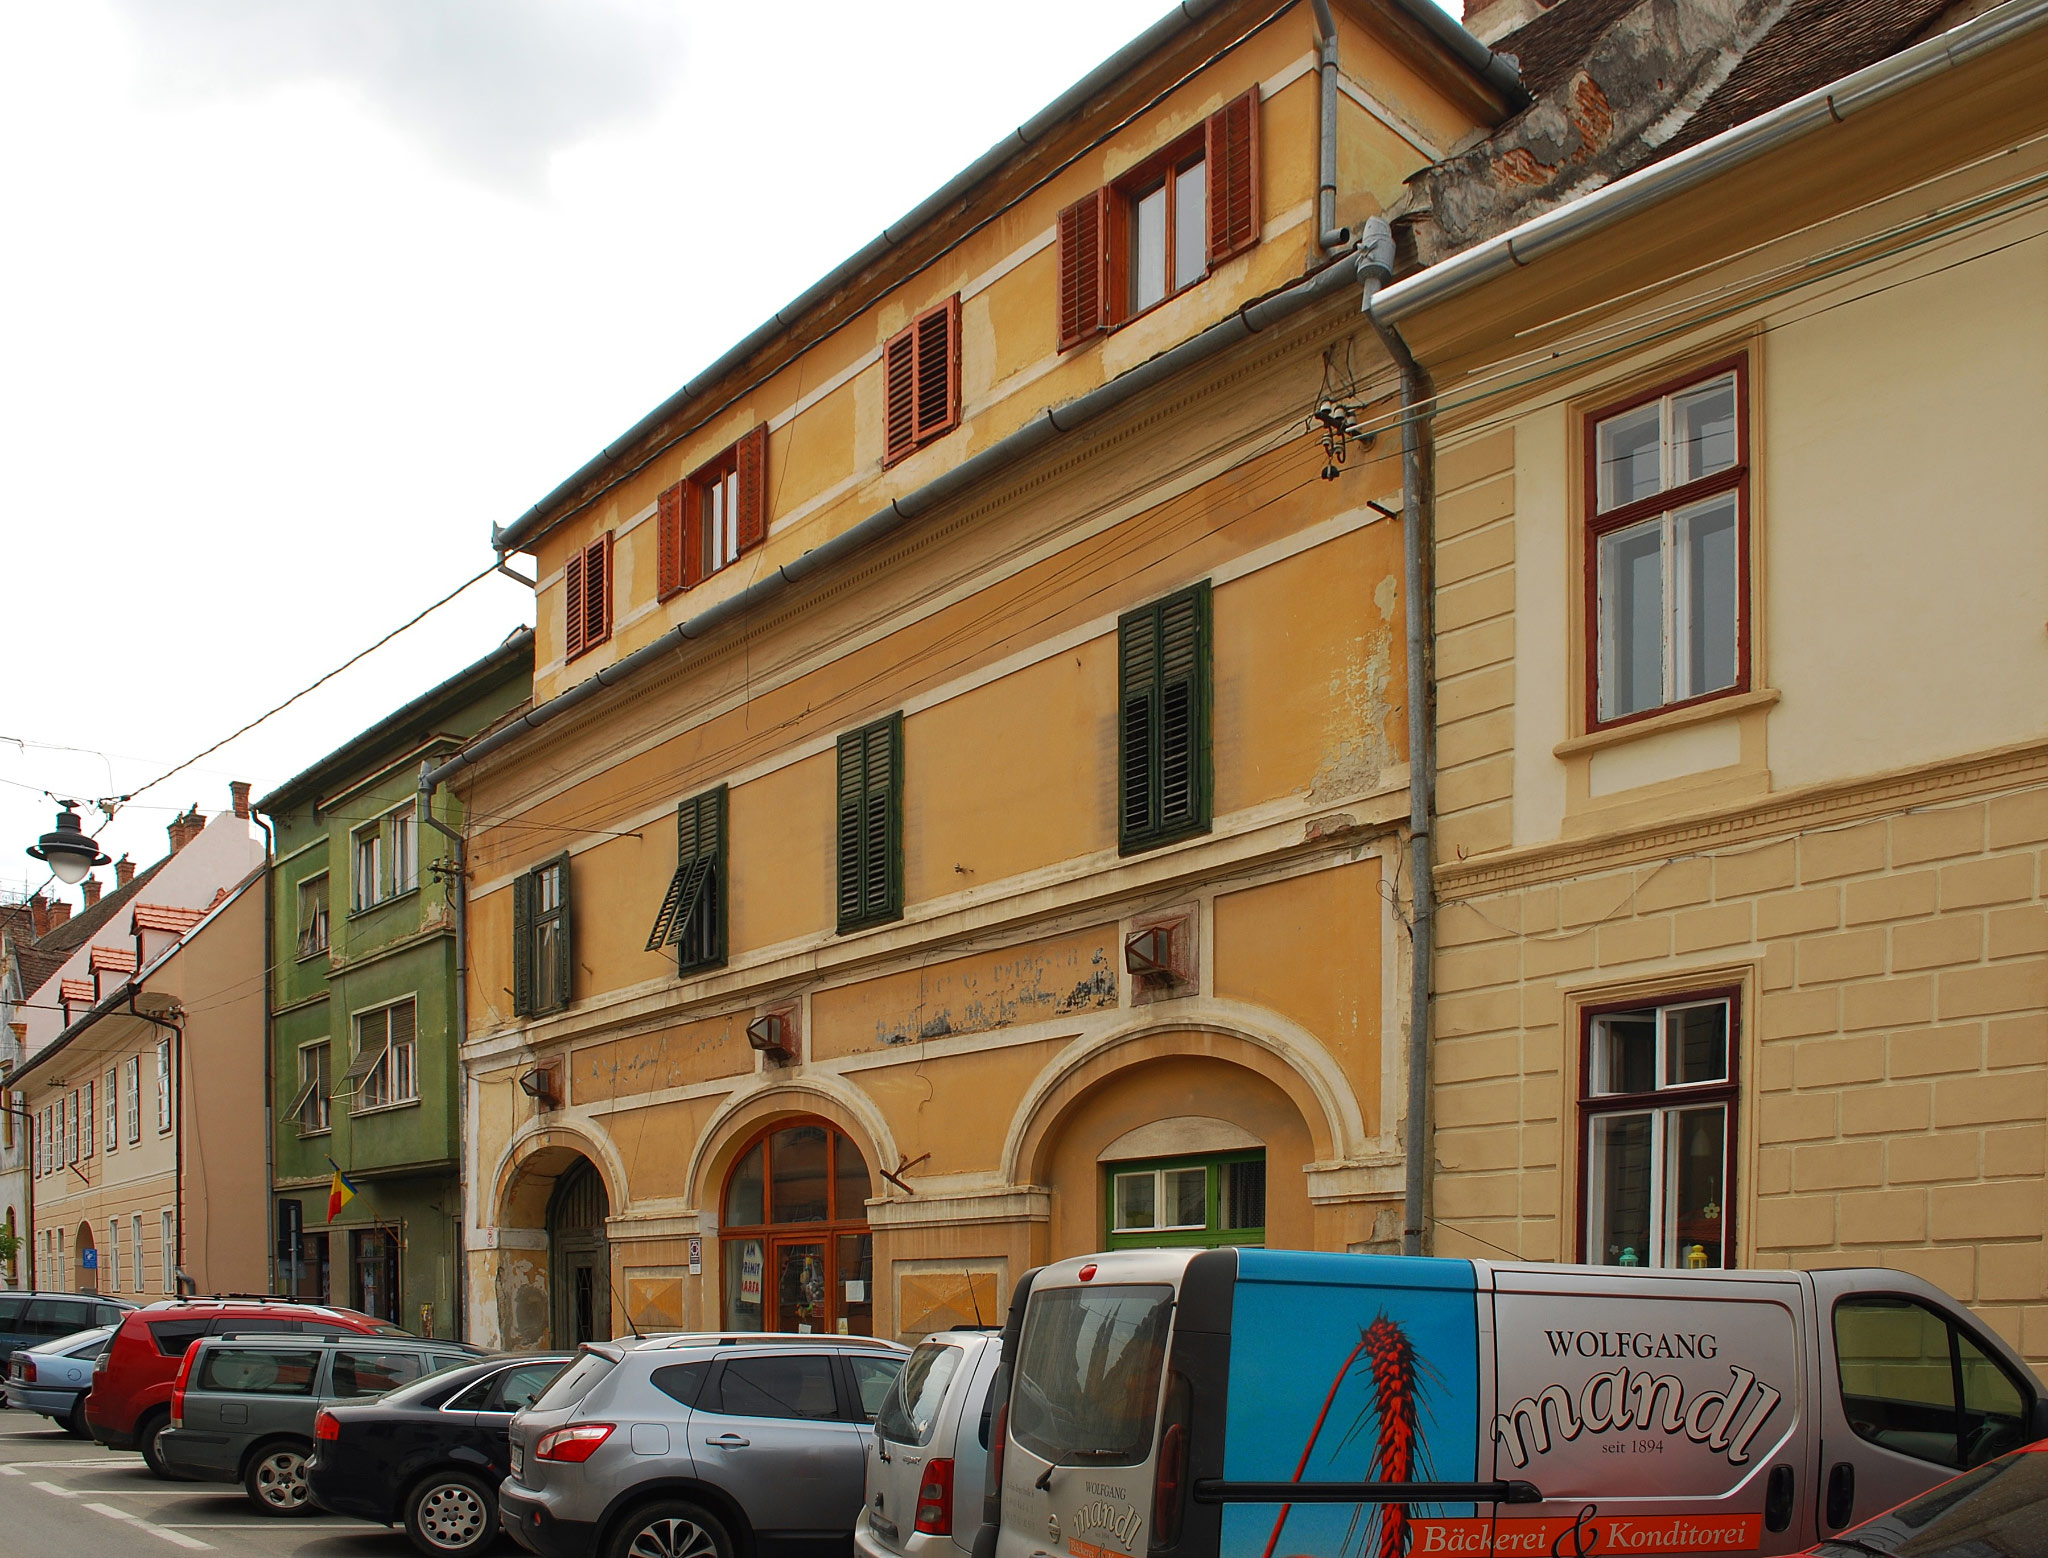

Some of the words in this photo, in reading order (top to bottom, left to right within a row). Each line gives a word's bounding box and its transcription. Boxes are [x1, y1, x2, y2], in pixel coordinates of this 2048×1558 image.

[1544, 1330, 1718, 1359] WOLFGANG
[1490, 1364, 1781, 1468] mandl
[1602, 1441, 1626, 1454] seit
[1631, 1439, 1664, 1453] 1894
[1086, 1481, 1126, 1500] WOLFGANG
[1073, 1499, 1142, 1551] mandl
[1422, 1524, 1546, 1552] Bäckerei
[1551, 1503, 1599, 1558] &
[1606, 1520, 1747, 1548] Konditorei
